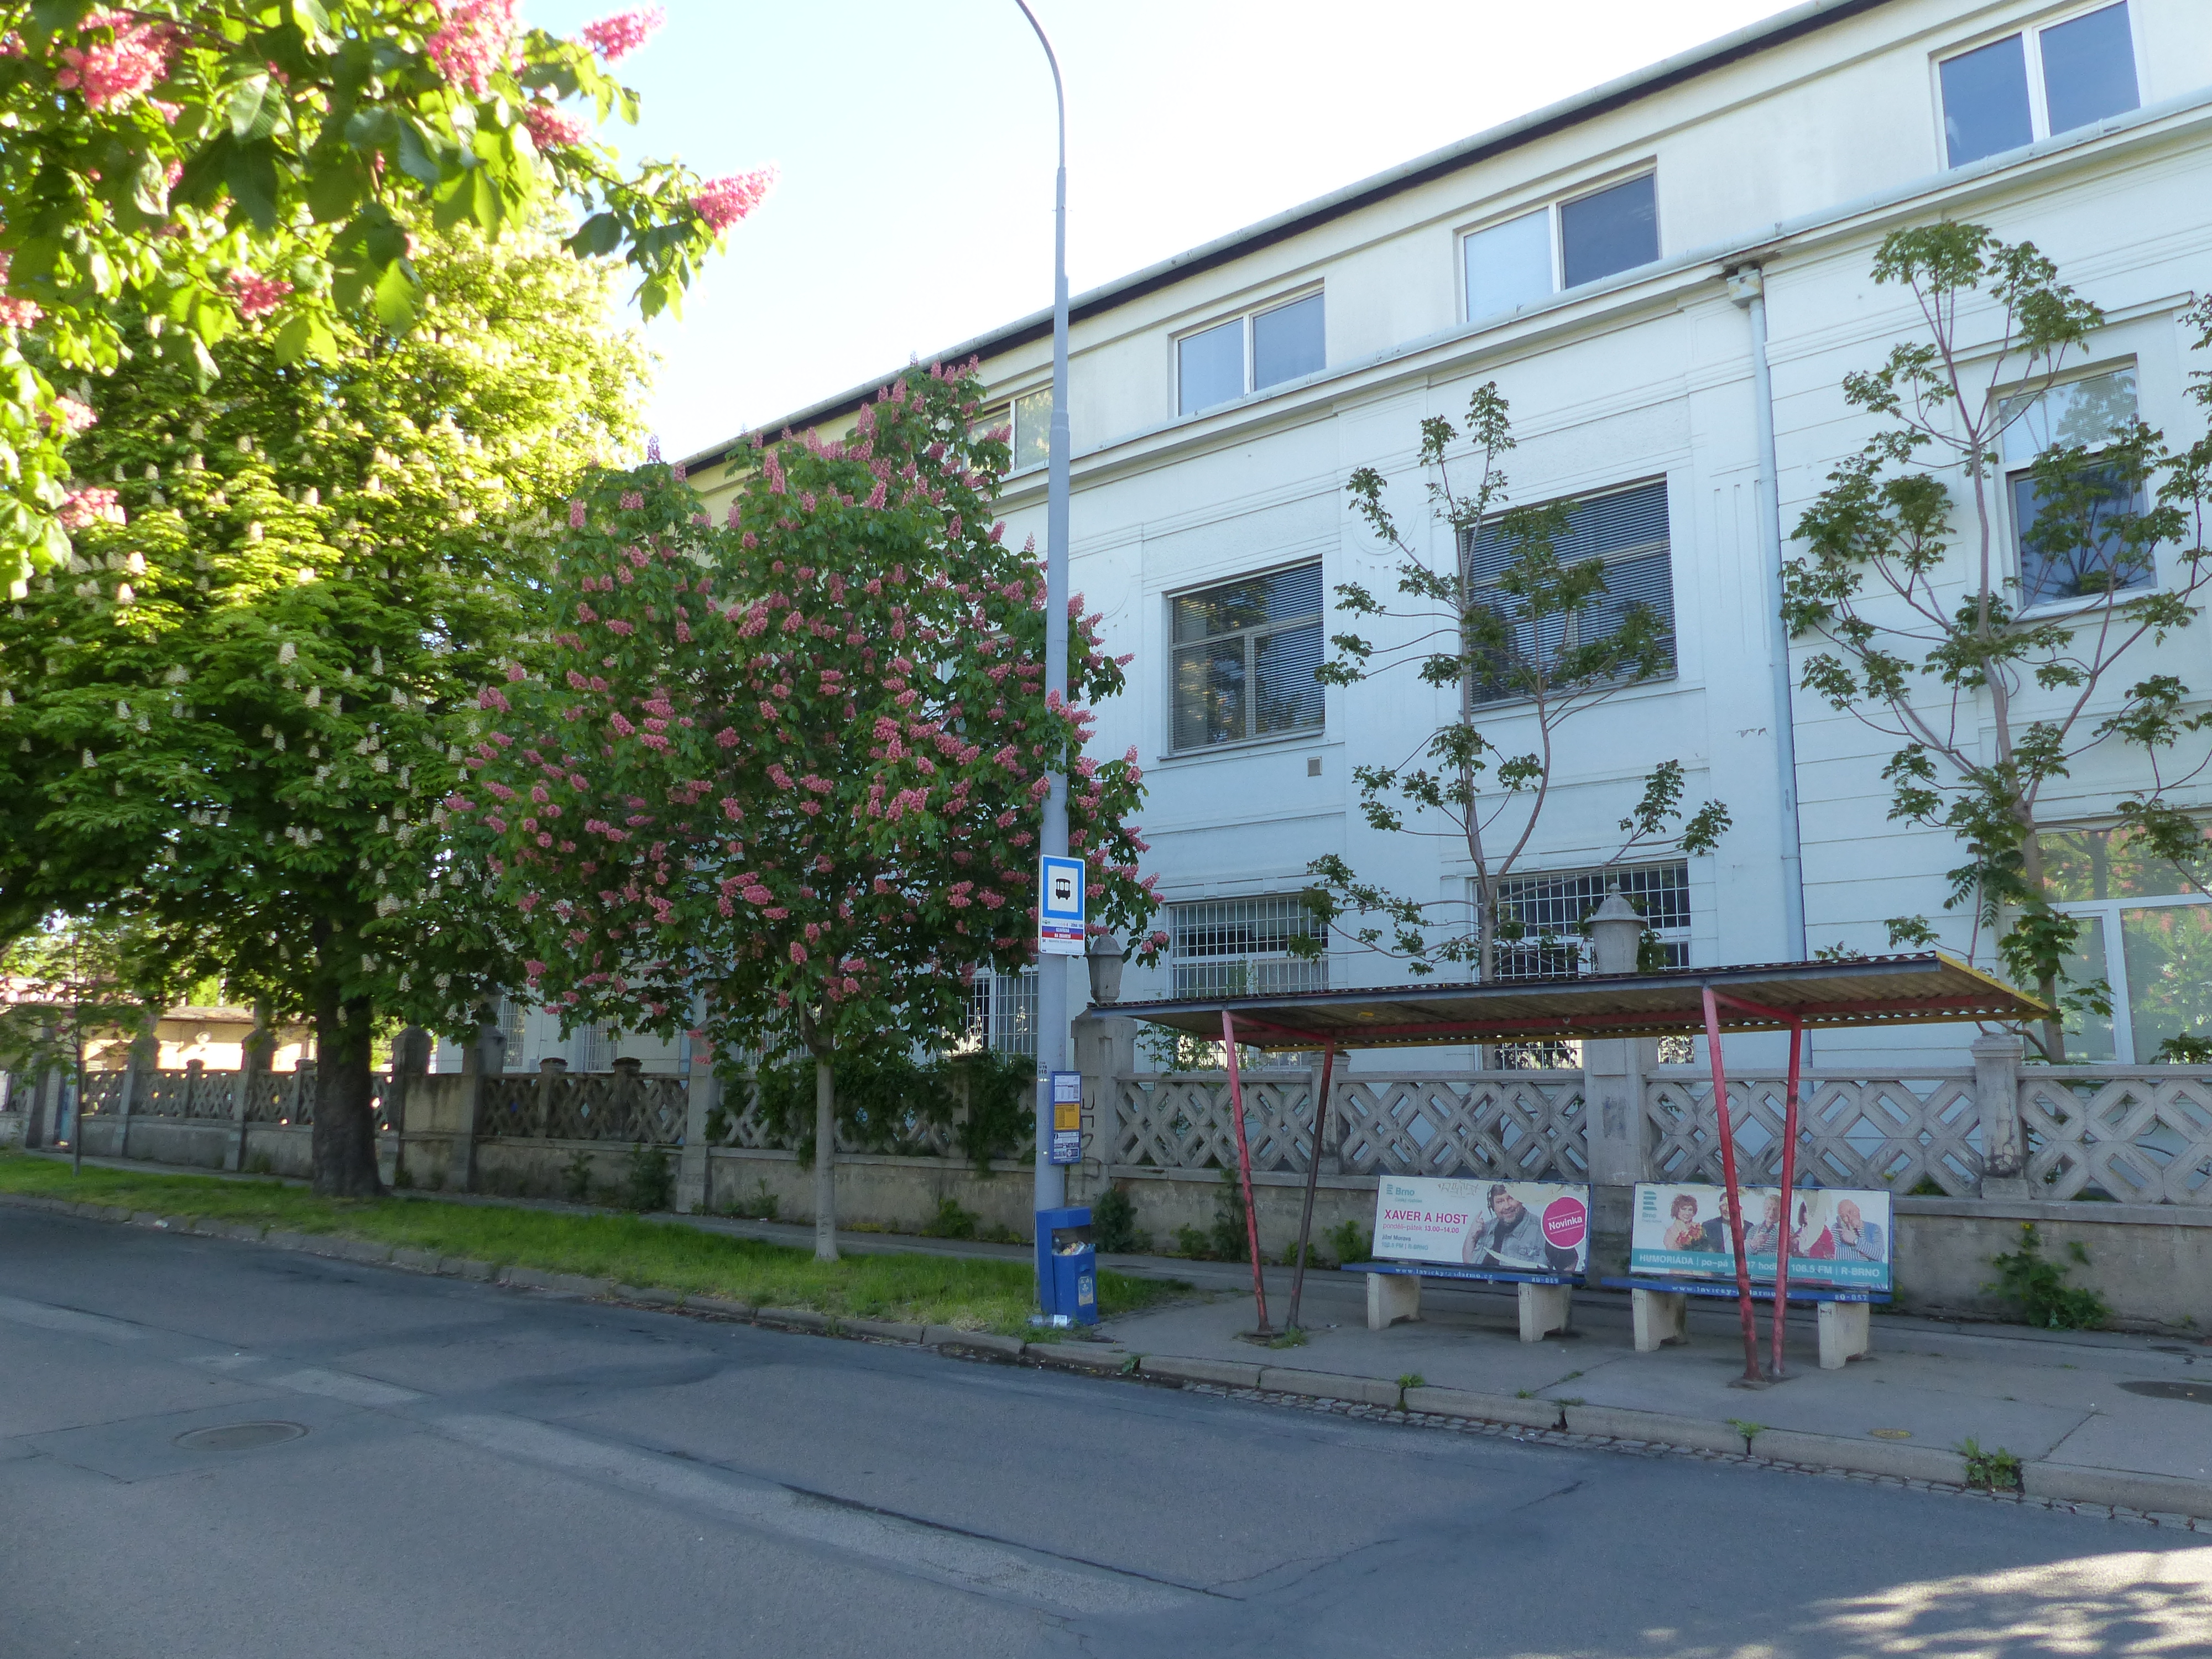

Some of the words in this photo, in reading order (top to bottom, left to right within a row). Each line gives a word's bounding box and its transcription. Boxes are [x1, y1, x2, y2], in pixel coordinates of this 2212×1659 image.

[1395, 1187, 1415, 1196] Brno
[1384, 1209, 1421, 1221] XAVER
[1424, 1212, 1432, 1222] A
[1436, 1213, 1468, 1224] HOST
[1548, 1216, 1583, 1230] Novinka
[1640, 1254, 1693, 1265] HUMORIÁDA
[1791, 1264, 1815, 1272] 106.5
[1818, 1265, 1832, 1274] FM
[1841, 1266, 1880, 1277] R-BRNO
